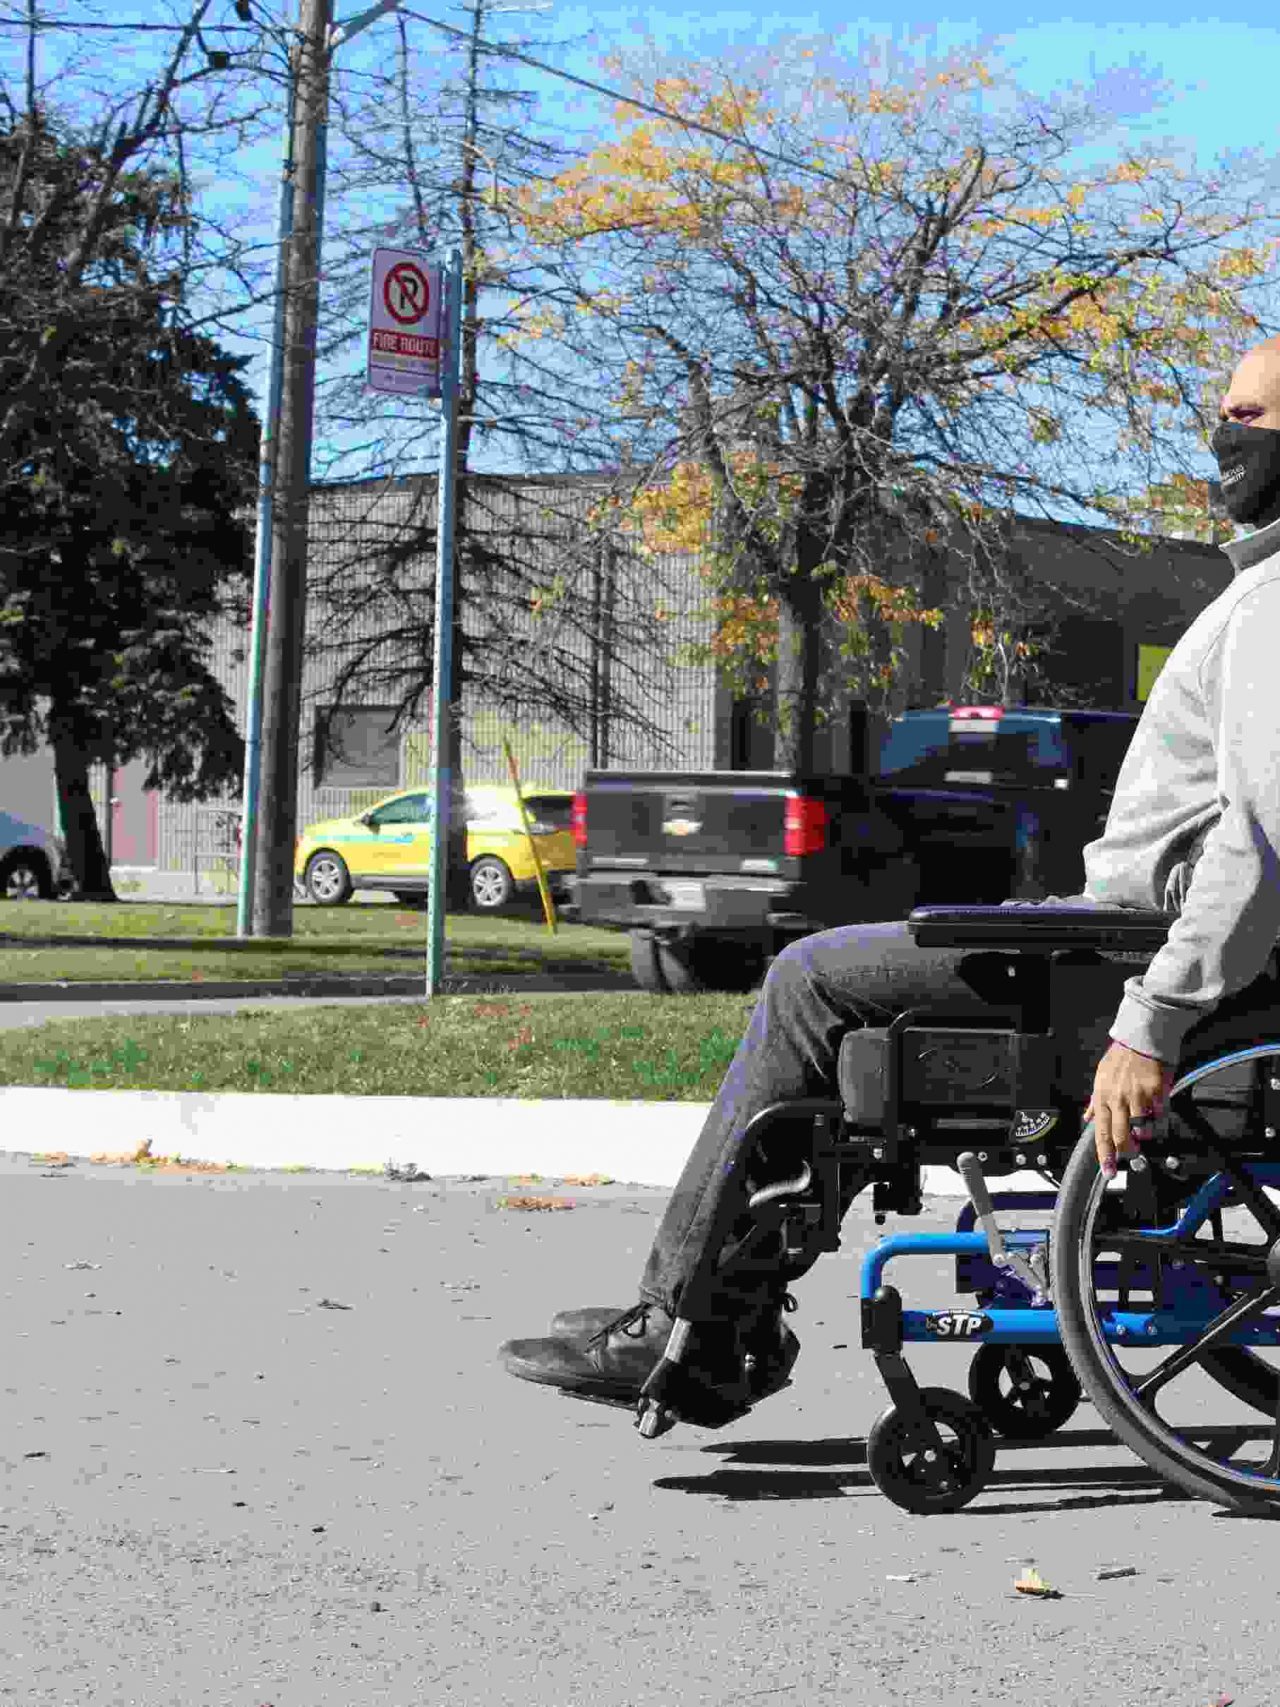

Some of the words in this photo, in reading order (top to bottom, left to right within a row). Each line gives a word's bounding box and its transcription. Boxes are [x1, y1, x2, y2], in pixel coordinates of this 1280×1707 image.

[373, 332, 398, 351] FIRE
[400, 337, 436, 356] ROUTE
[936, 1314, 982, 1335] STP
